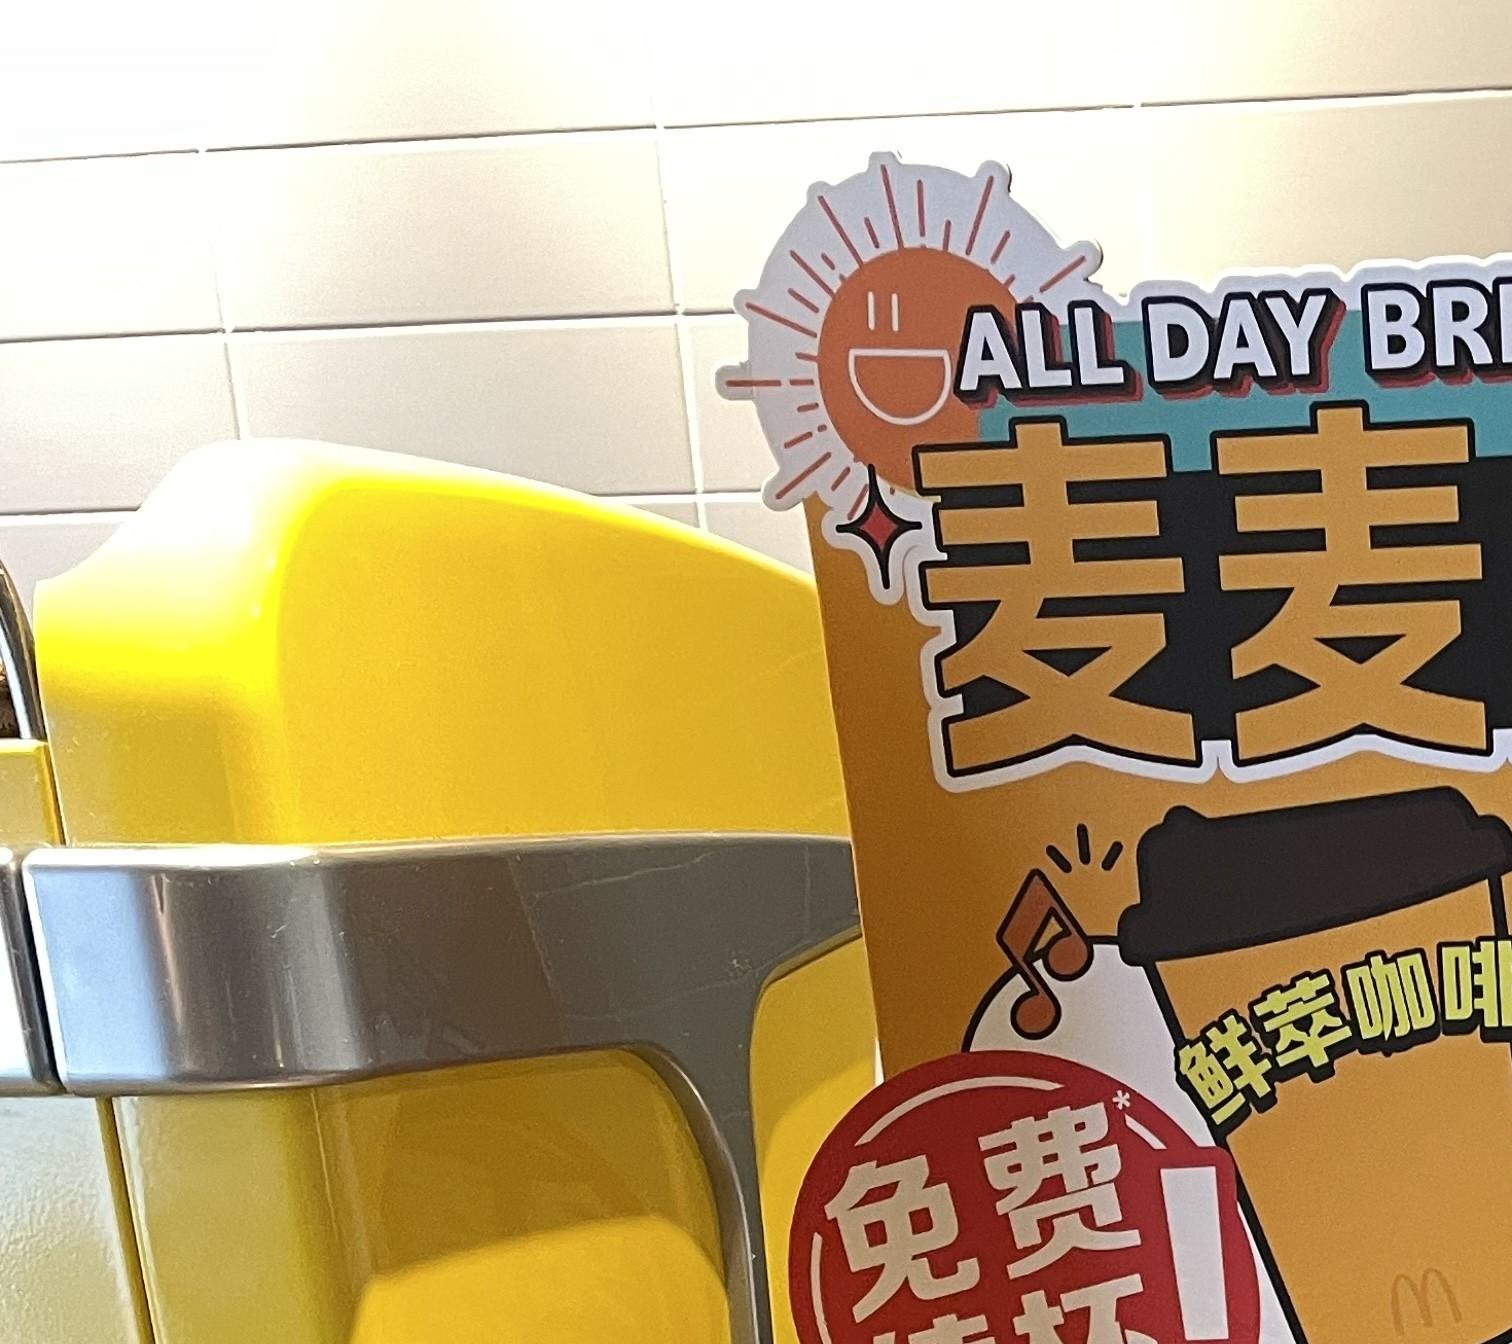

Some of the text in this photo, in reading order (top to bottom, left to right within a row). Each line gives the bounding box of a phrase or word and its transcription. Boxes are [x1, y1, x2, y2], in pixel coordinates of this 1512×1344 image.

[956, 303, 1130, 397] ALL
[1145, 293, 1330, 384] DAY
[824, 1100, 1142, 1324] 免费
